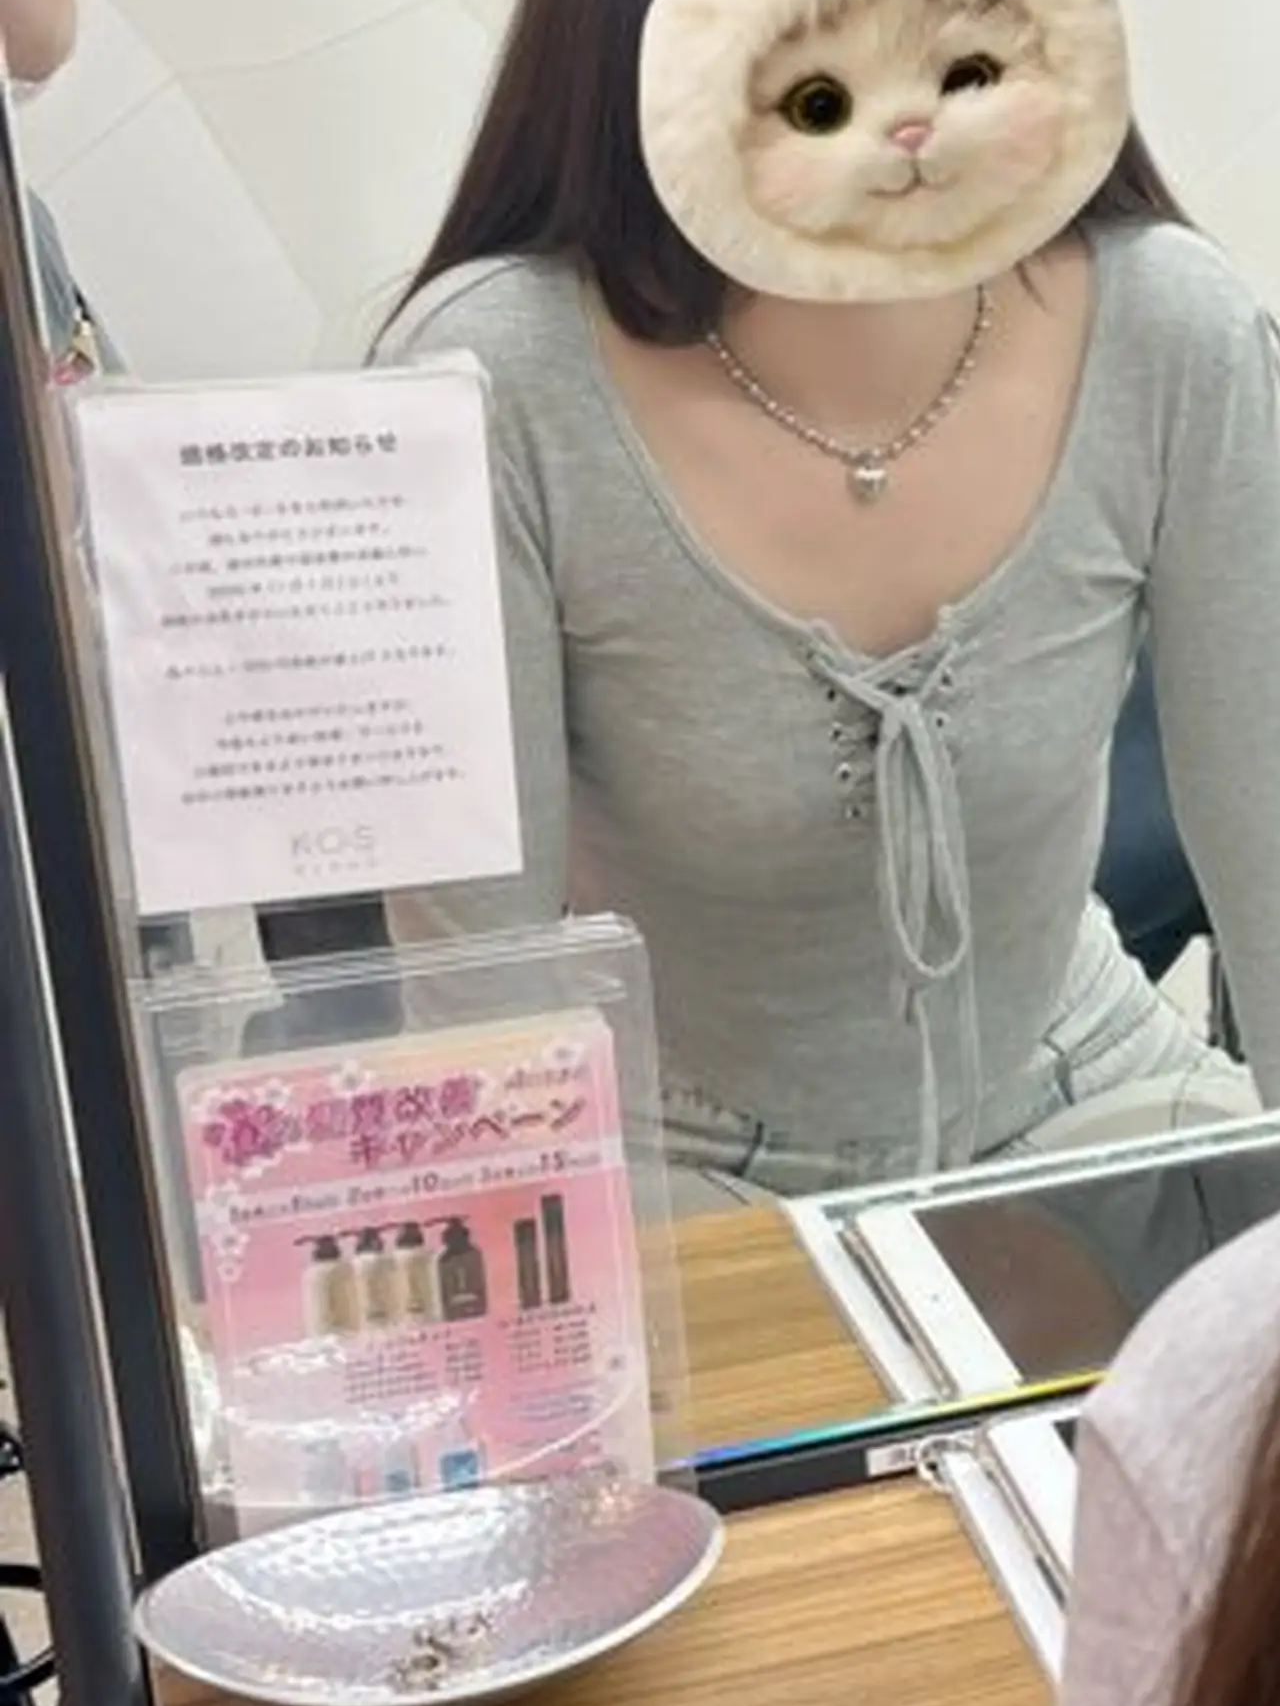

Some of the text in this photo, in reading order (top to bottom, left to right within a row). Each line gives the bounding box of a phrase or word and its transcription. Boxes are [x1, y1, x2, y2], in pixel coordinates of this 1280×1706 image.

[178, 431, 397, 467] 価格改定のお知らせ
[349, 1097, 587, 1169] キャンペーン
